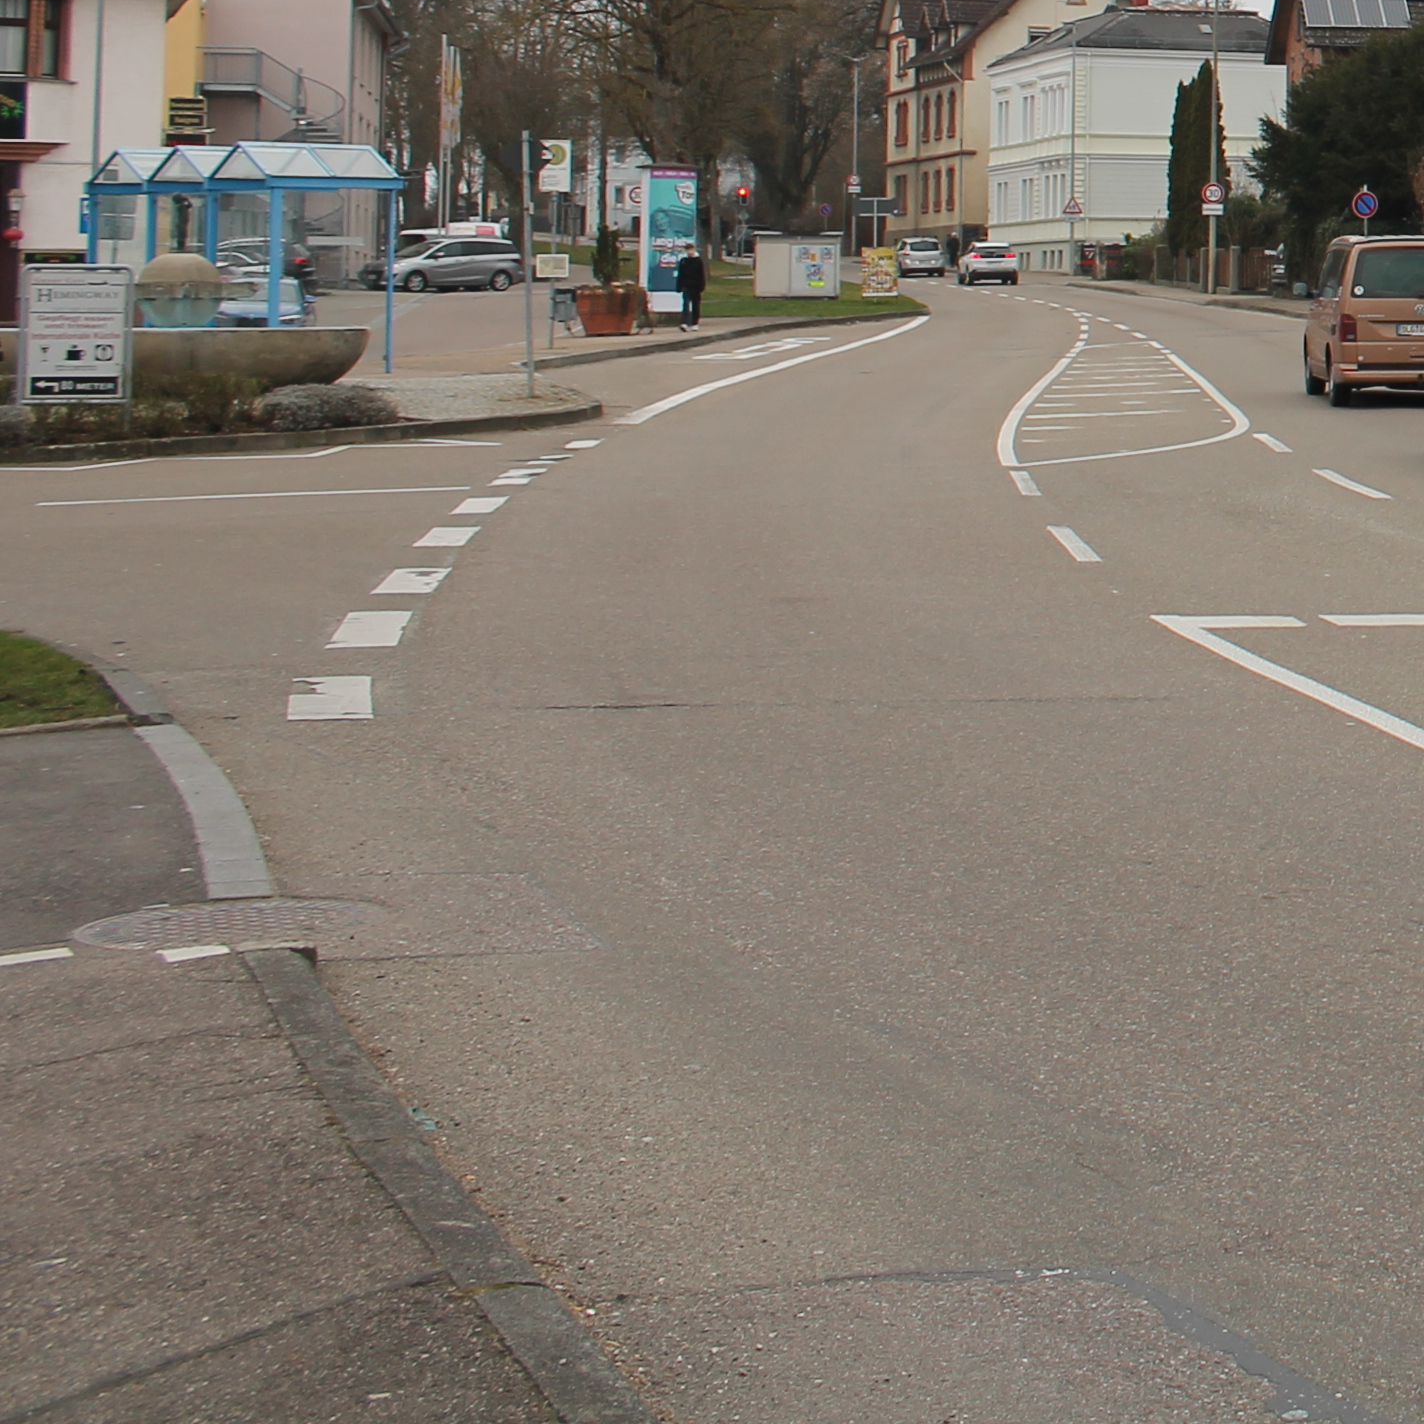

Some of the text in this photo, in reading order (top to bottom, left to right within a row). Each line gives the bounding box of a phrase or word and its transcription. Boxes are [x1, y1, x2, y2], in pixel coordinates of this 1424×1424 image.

[1207, 188, 1220, 198] 30
[36, 288, 119, 303] HEMINGWAY
[76, 383, 116, 391] METER
